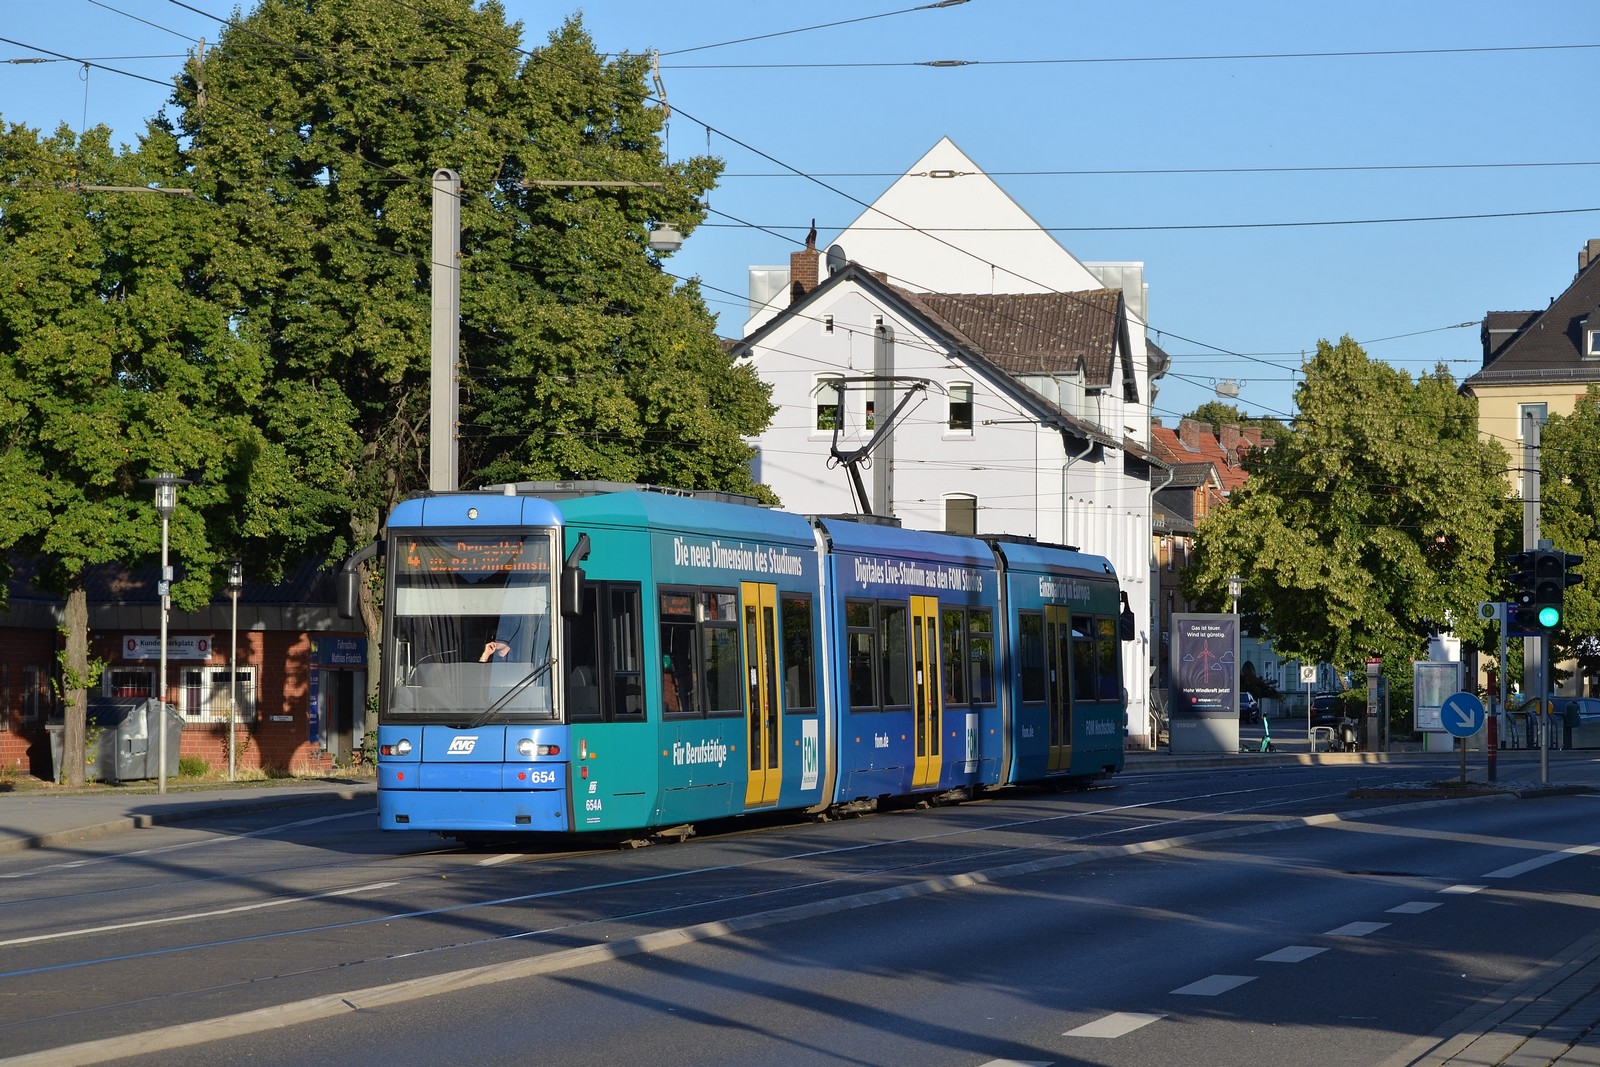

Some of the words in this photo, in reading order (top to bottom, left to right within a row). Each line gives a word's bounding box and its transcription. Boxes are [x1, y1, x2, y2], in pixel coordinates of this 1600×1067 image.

[674, 536, 689, 567] Die
[690, 545, 711, 568] neue
[711, 540, 754, 572] Dimension
[754, 544, 768, 574] des
[768, 547, 802, 576] Studiums
[855, 556, 884, 589] Digitales
[884, 559, 926, 587] Live-Studium
[925, 569, 936, 588] aus
[937, 565, 948, 589] den
[948, 568, 962, 591] FOM
[962, 569, 983, 593] Studios
[1039, 576, 1067, 604] Einzigartig
[1073, 580, 1090, 606] Europa
[1022, 724, 1034, 739] fom.de
[1086, 720, 1094, 736] FOM
[1095, 718, 1116, 735] Hochschule
[448, 738, 477, 752] KVG
[874, 732, 889, 748] fom.de
[967, 728, 978, 759] FOM
[673, 740, 685, 766] Für
[686, 738, 727, 768] Berufstätige
[804, 736, 817, 772] FOM
[531, 771, 556, 784] 654
[586, 798, 602, 811] 654A
